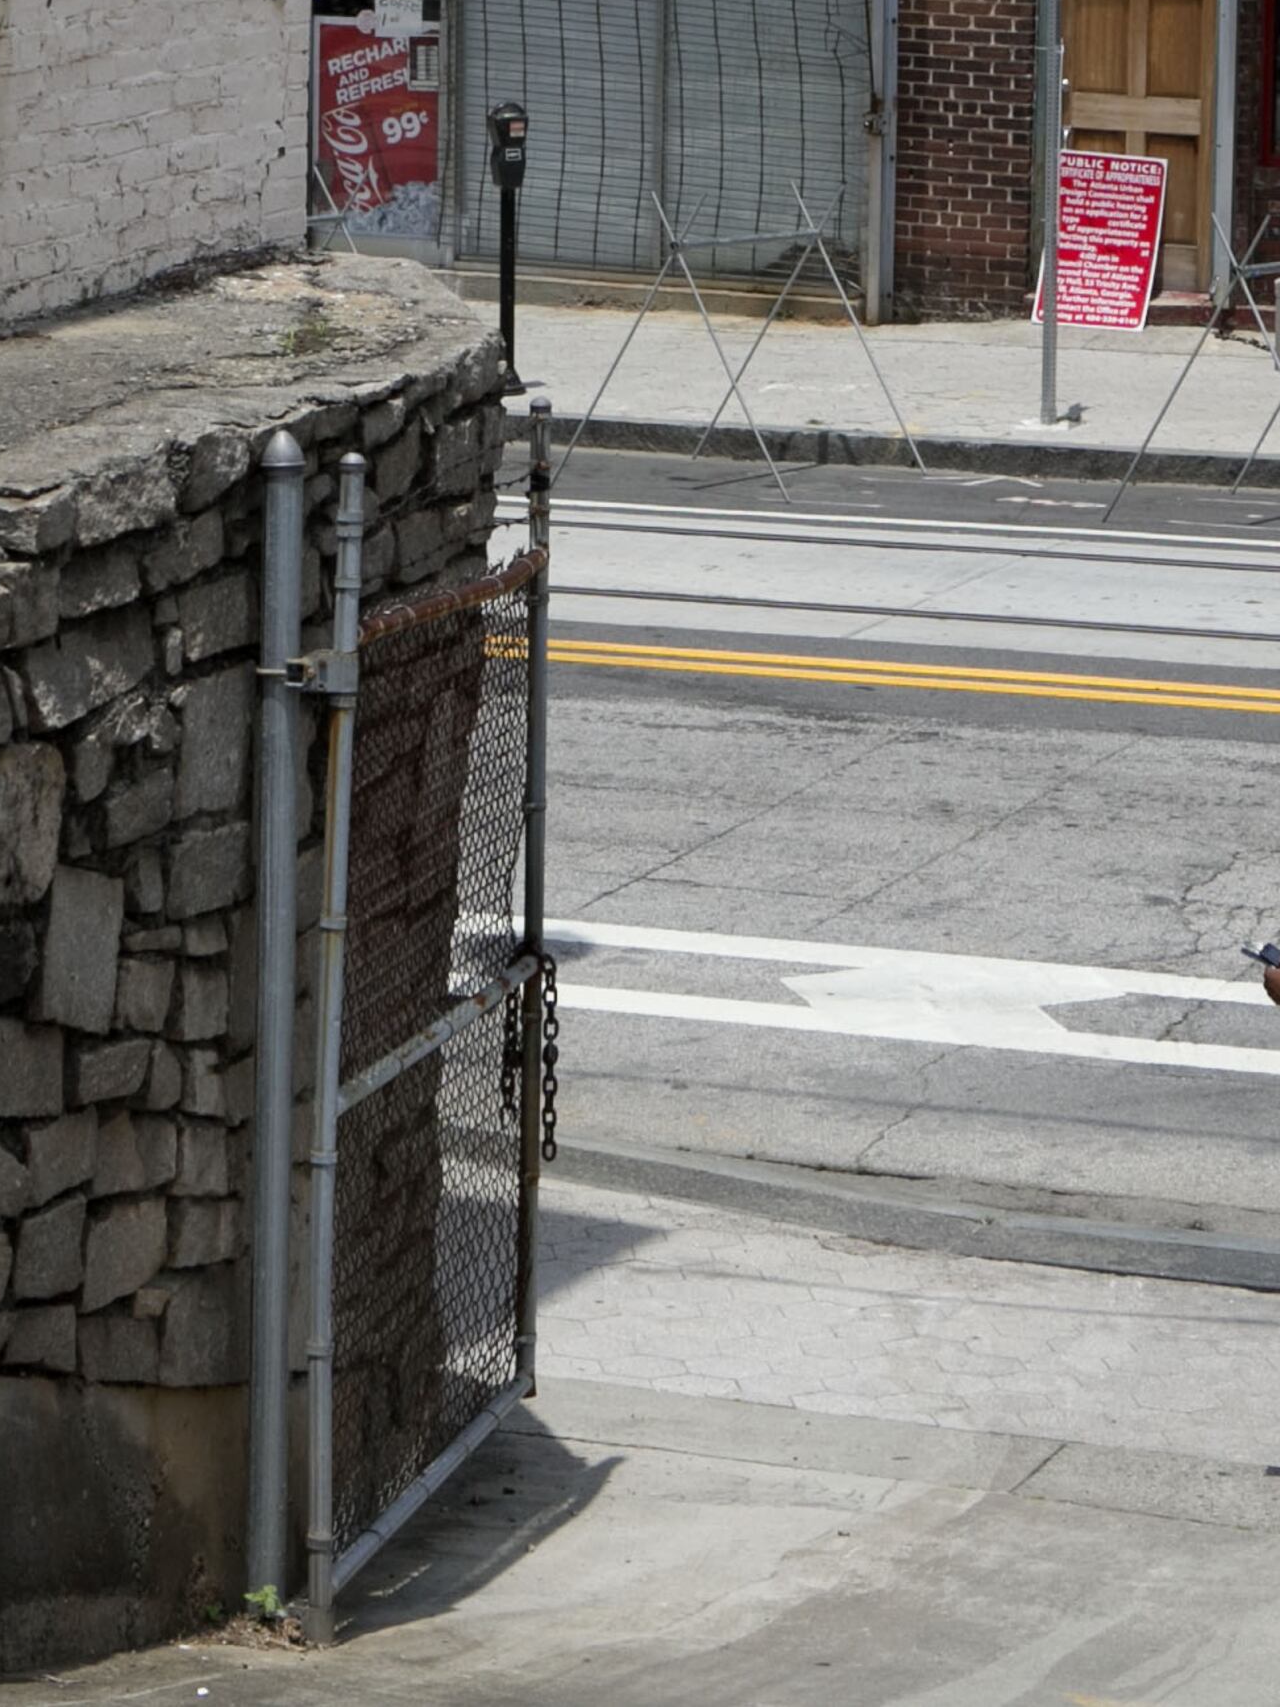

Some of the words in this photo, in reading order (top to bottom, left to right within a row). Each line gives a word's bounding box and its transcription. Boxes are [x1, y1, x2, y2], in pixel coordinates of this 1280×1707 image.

[327, 36, 409, 76] RECHAR
[338, 67, 370, 88] AND
[1059, 155, 1105, 169] PUBLIC
[1109, 162, 1162, 175] NOTICE:
[1072, 180, 1088, 188] The
[1090, 182, 1119, 190] Atlanta
[1119, 185, 1144, 193] Urban
